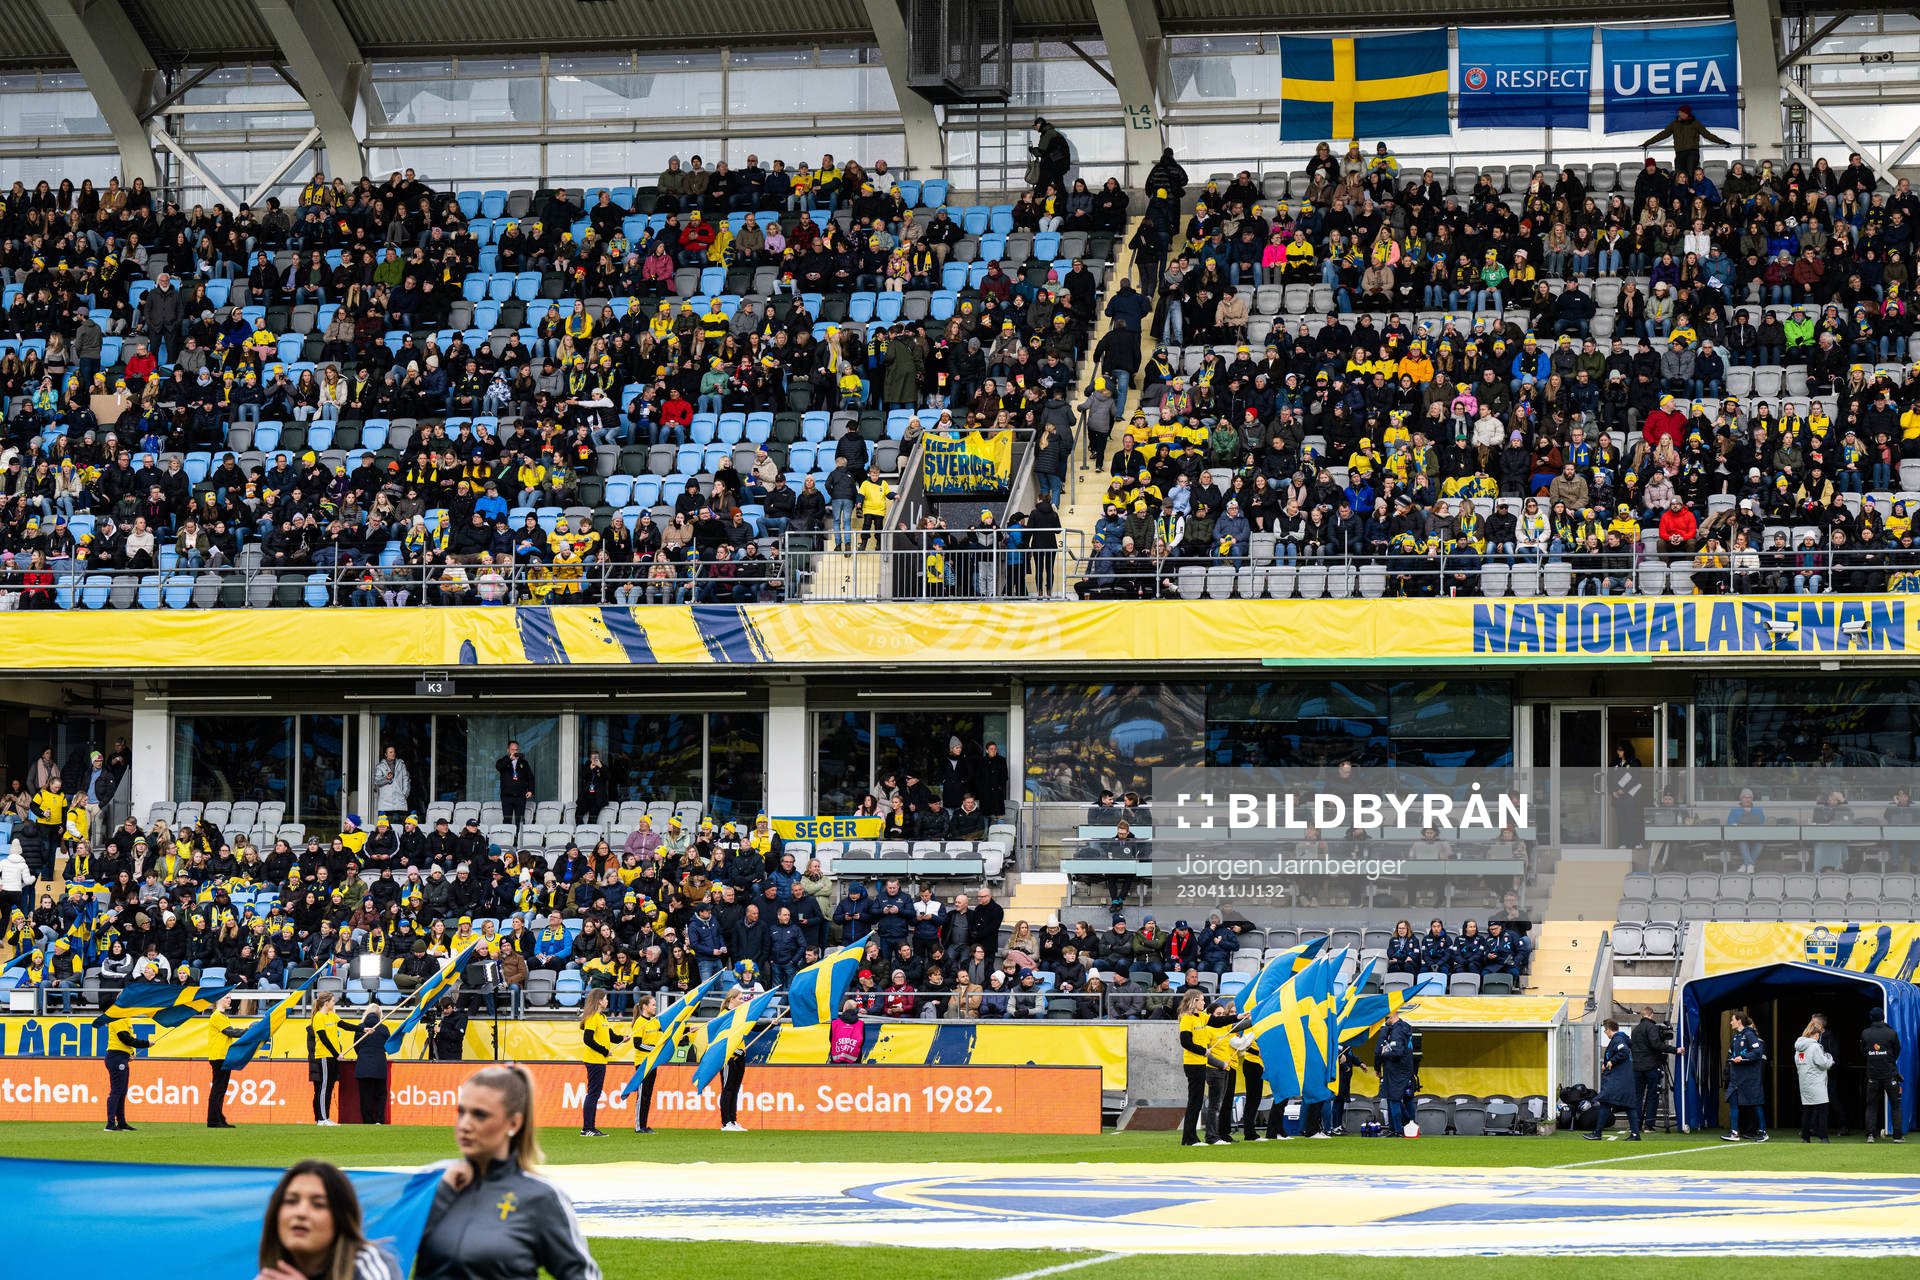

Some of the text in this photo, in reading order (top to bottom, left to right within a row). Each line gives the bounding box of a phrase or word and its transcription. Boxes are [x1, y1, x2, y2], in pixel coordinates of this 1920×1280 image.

[1496, 69, 1589, 88] RESPECT
[1613, 60, 1727, 96] UEFA
[1129, 104, 1151, 115] L4
[1132, 117, 1152, 129] L5
[1079, 475, 1085, 483] 5
[1068, 507, 1074, 515] 4
[1473, 601, 1905, 651] NATIONALARENAN
[428, 683, 442, 693] K3
[795, 821, 857, 838] SEGER
[46, 884, 52, 892] 6
[0, 1076, 287, 1107] tchen. edan 982.
[562, 1082, 1003, 1113] Med mathen. Sedan 1982.
